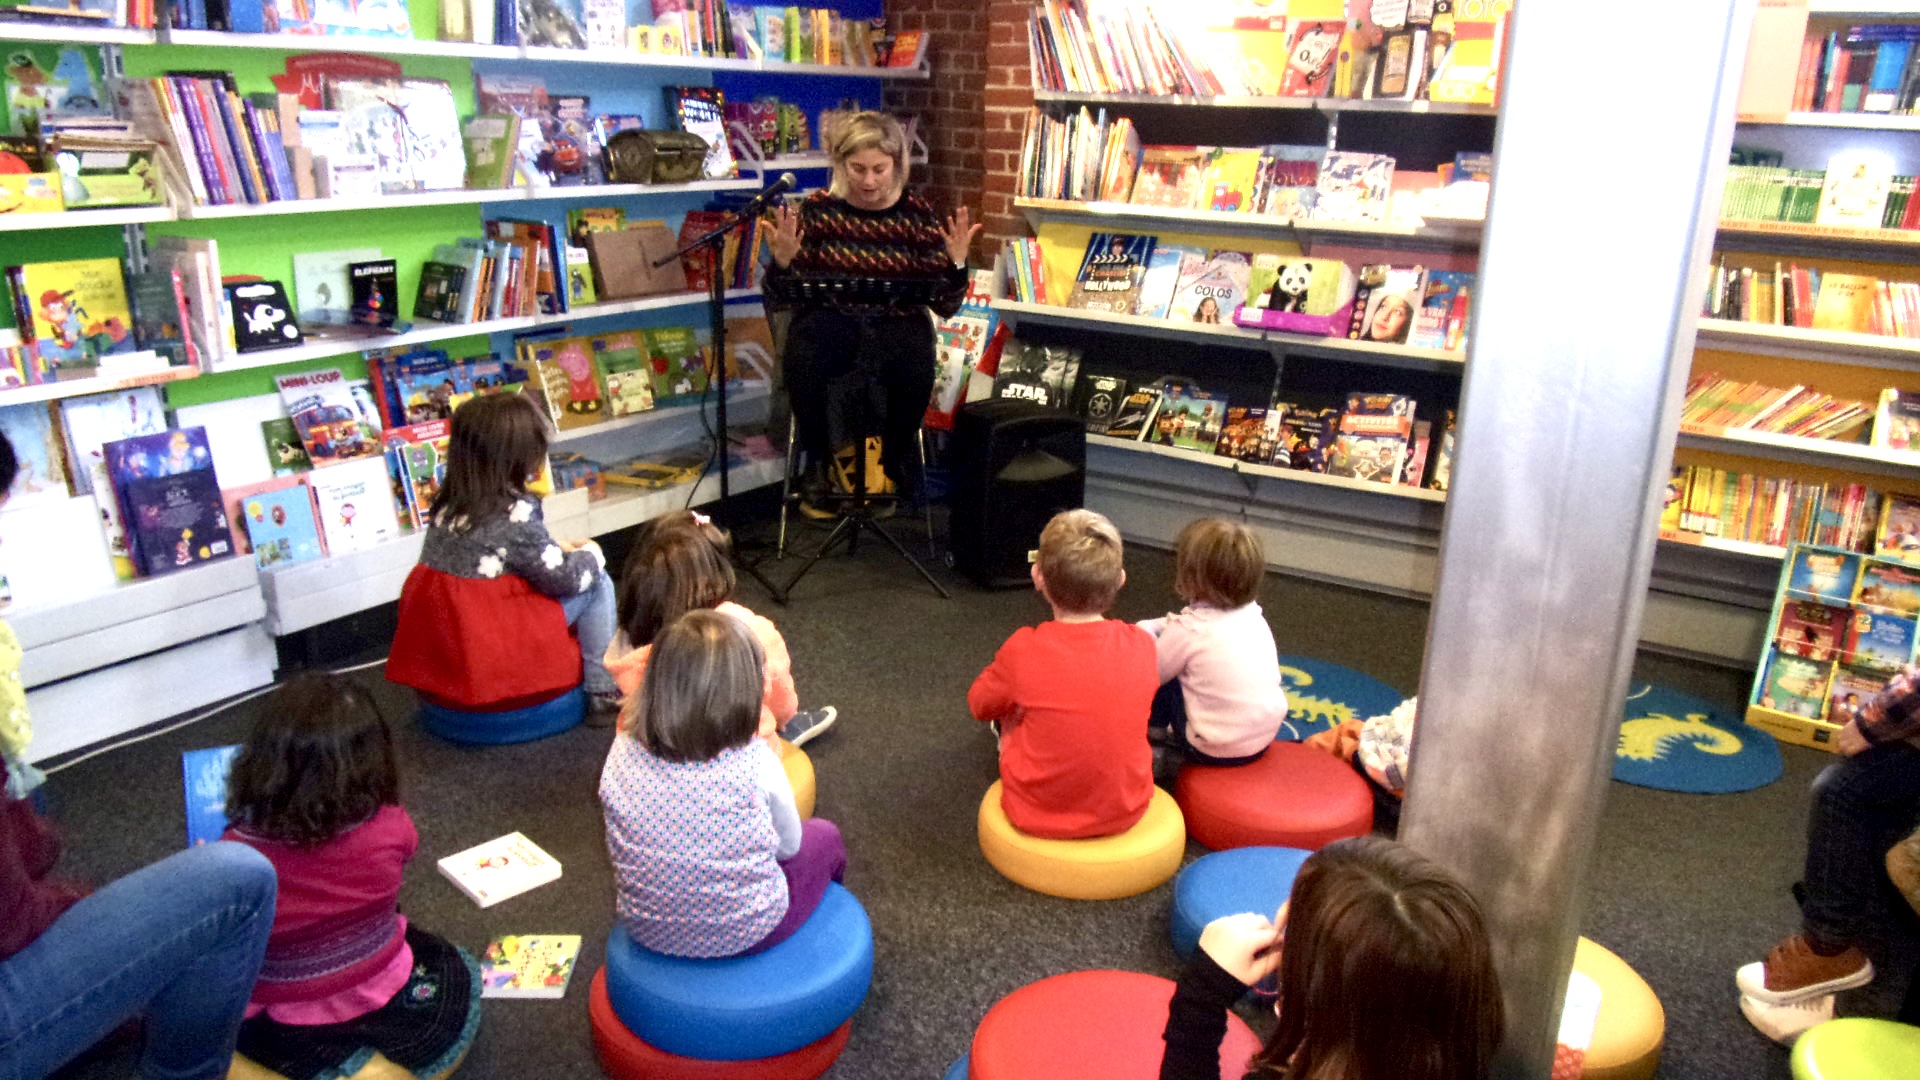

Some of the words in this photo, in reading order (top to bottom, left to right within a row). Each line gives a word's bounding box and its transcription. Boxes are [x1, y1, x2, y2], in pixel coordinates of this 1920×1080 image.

[1439, 82, 1476, 98] TOTO
[354, 266, 394, 276] ELEPHANT
[1084, 280, 1132, 292] HOLLYWOOD
[1195, 285, 1233, 299] COLOS
[280, 370, 341, 388] MINI-LOUP
[1001, 383, 1048, 401] STAR
